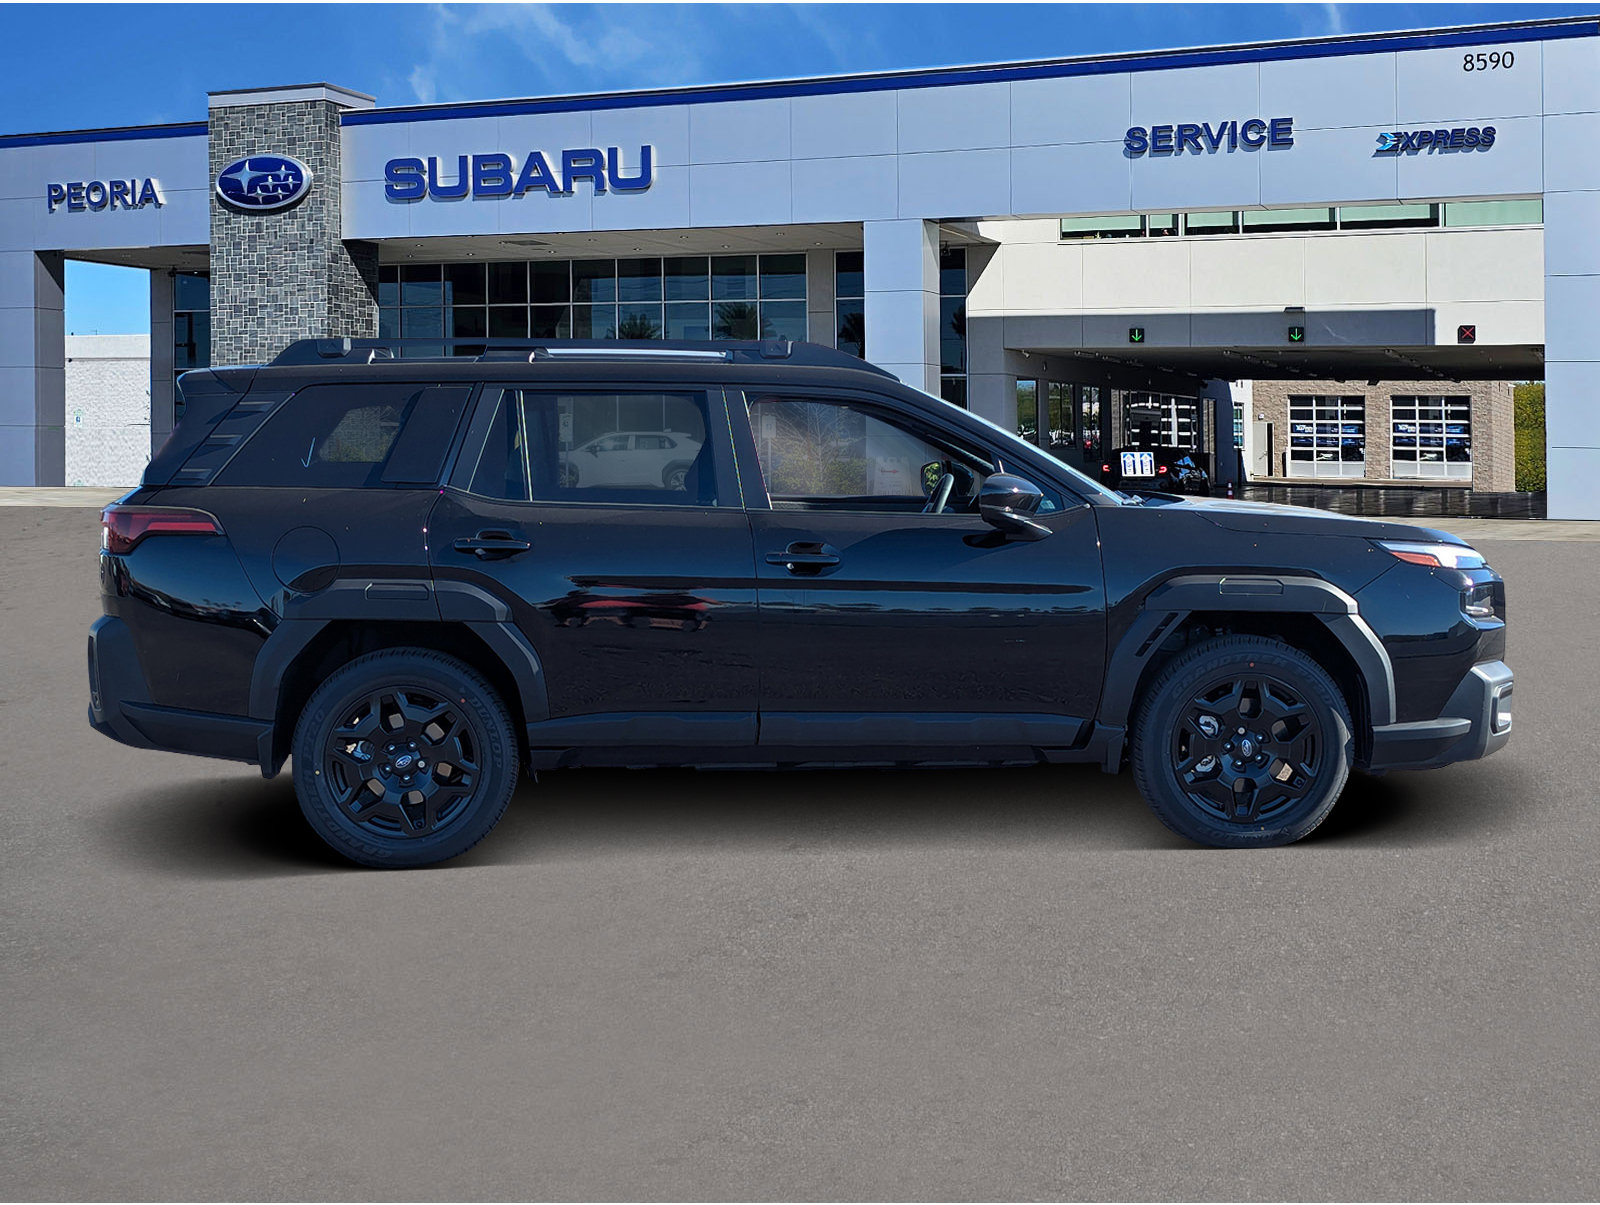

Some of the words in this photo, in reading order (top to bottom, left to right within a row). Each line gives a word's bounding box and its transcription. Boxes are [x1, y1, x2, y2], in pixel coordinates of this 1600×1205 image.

[1463, 51, 1515, 72] 8590
[1125, 117, 1294, 155] SERVICE
[384, 145, 653, 202] SUBARU
[47, 178, 163, 212] PEORIA
[469, 695, 503, 769] DUNLOP
